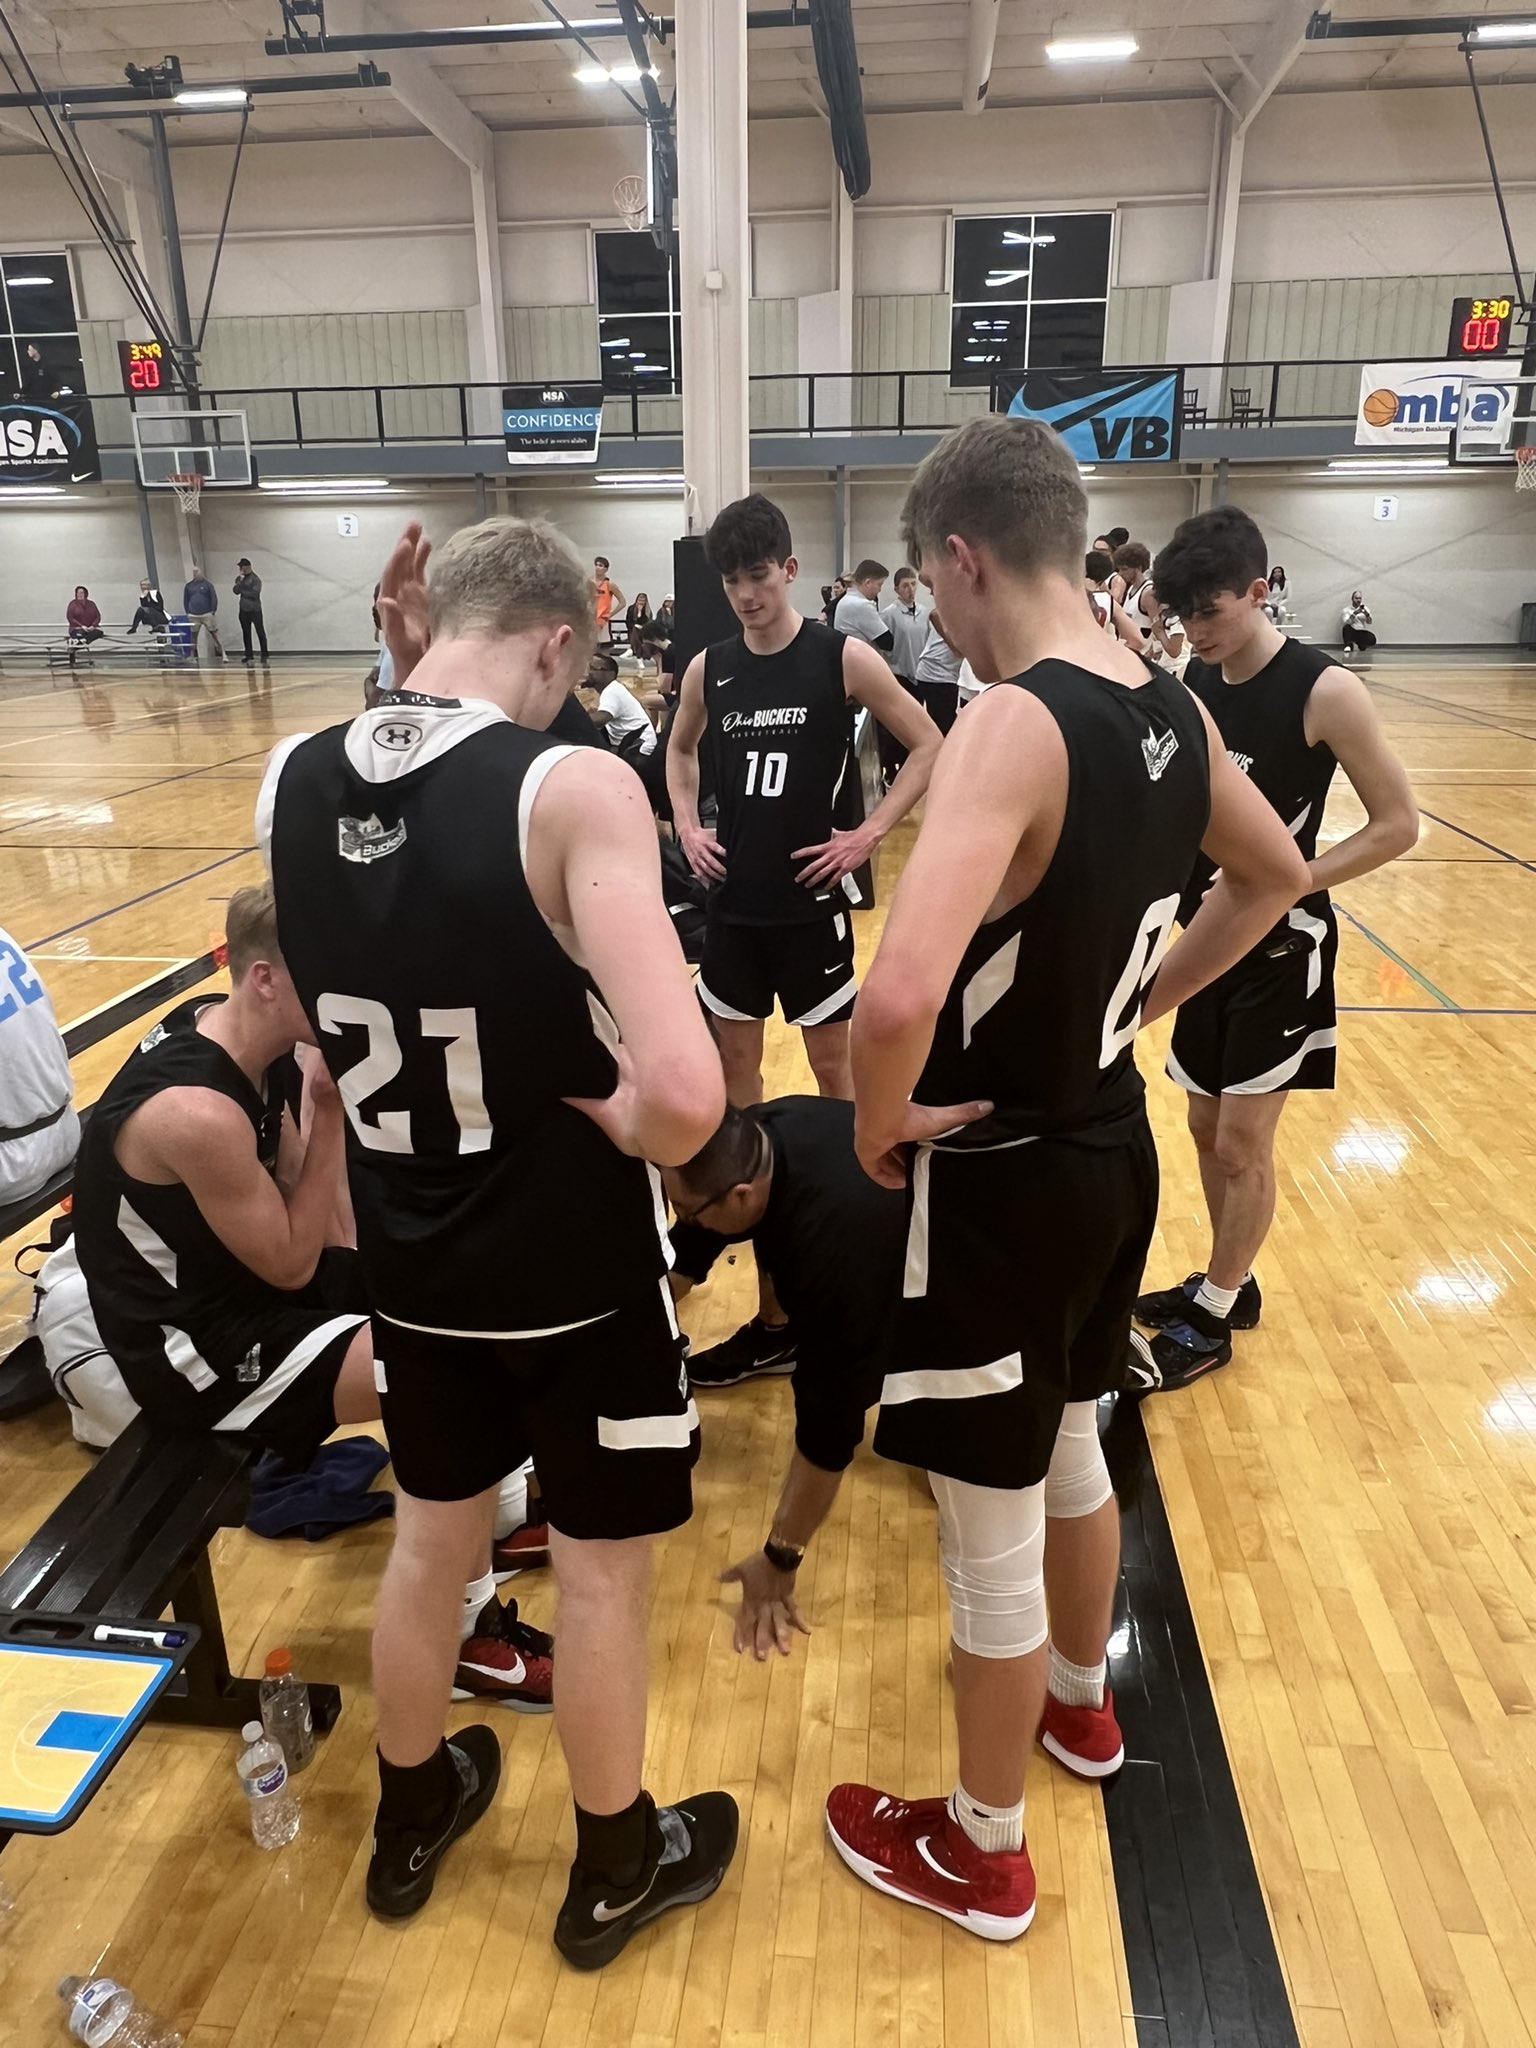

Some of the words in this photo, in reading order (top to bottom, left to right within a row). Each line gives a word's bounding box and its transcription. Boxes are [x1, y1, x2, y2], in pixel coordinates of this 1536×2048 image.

[1472, 300, 1510, 319] 3:30
[1463, 319, 1500, 351] 00
[130, 343, 162, 360] 3:49
[130, 360, 160, 389] 20
[1393, 386, 1500, 423] mba
[0, 420, 69, 457] SA
[1090, 416, 1169, 459] VB
[1425, 425, 1453, 433] Basketb
[1381, 506, 1389, 518] 3
[345, 523, 351, 534] 2
[752, 707, 808, 728] BUCKETS
[745, 751, 788, 797] 10
[316, 992, 493, 1154] 21
